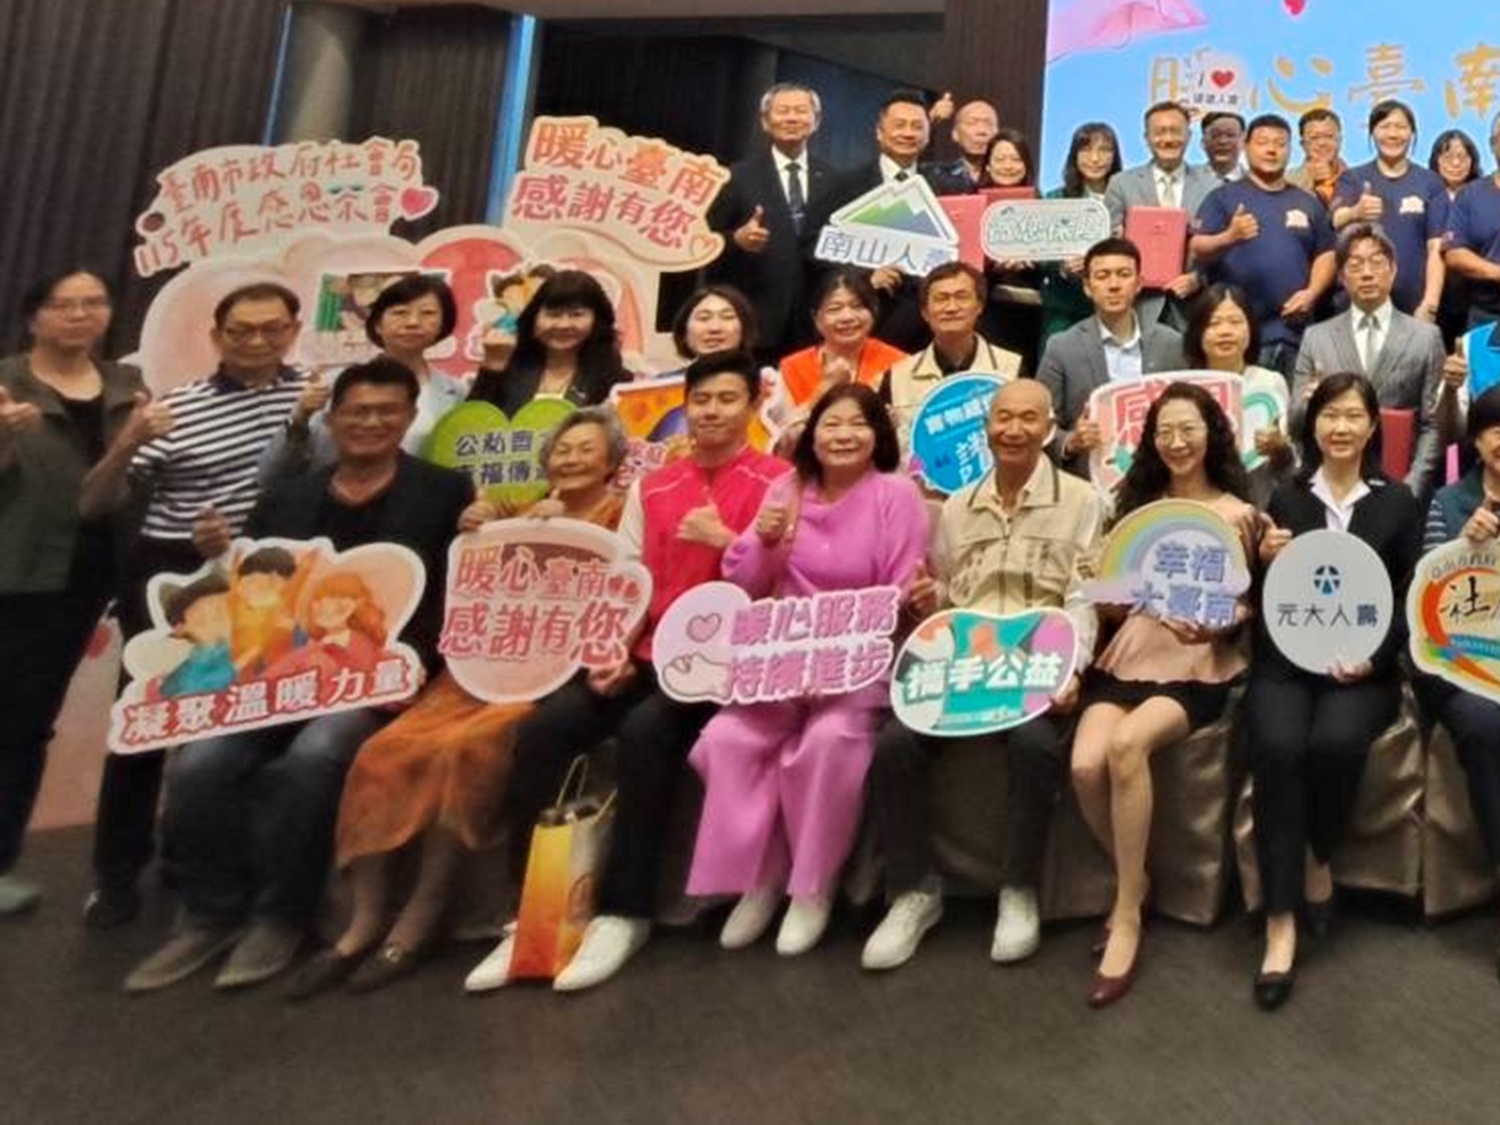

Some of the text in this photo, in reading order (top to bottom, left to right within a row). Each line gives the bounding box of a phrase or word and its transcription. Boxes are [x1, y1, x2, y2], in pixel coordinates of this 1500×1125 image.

[533, 122, 725, 206] 暖心臺南
[513, 174, 697, 248] 感謝有您
[456, 545, 610, 601] 暖心臺南
[440, 601, 628, 667] 感謝有您
[731, 588, 899, 646] 暖心服務
[1277, 603, 1379, 627] 元大人壽
